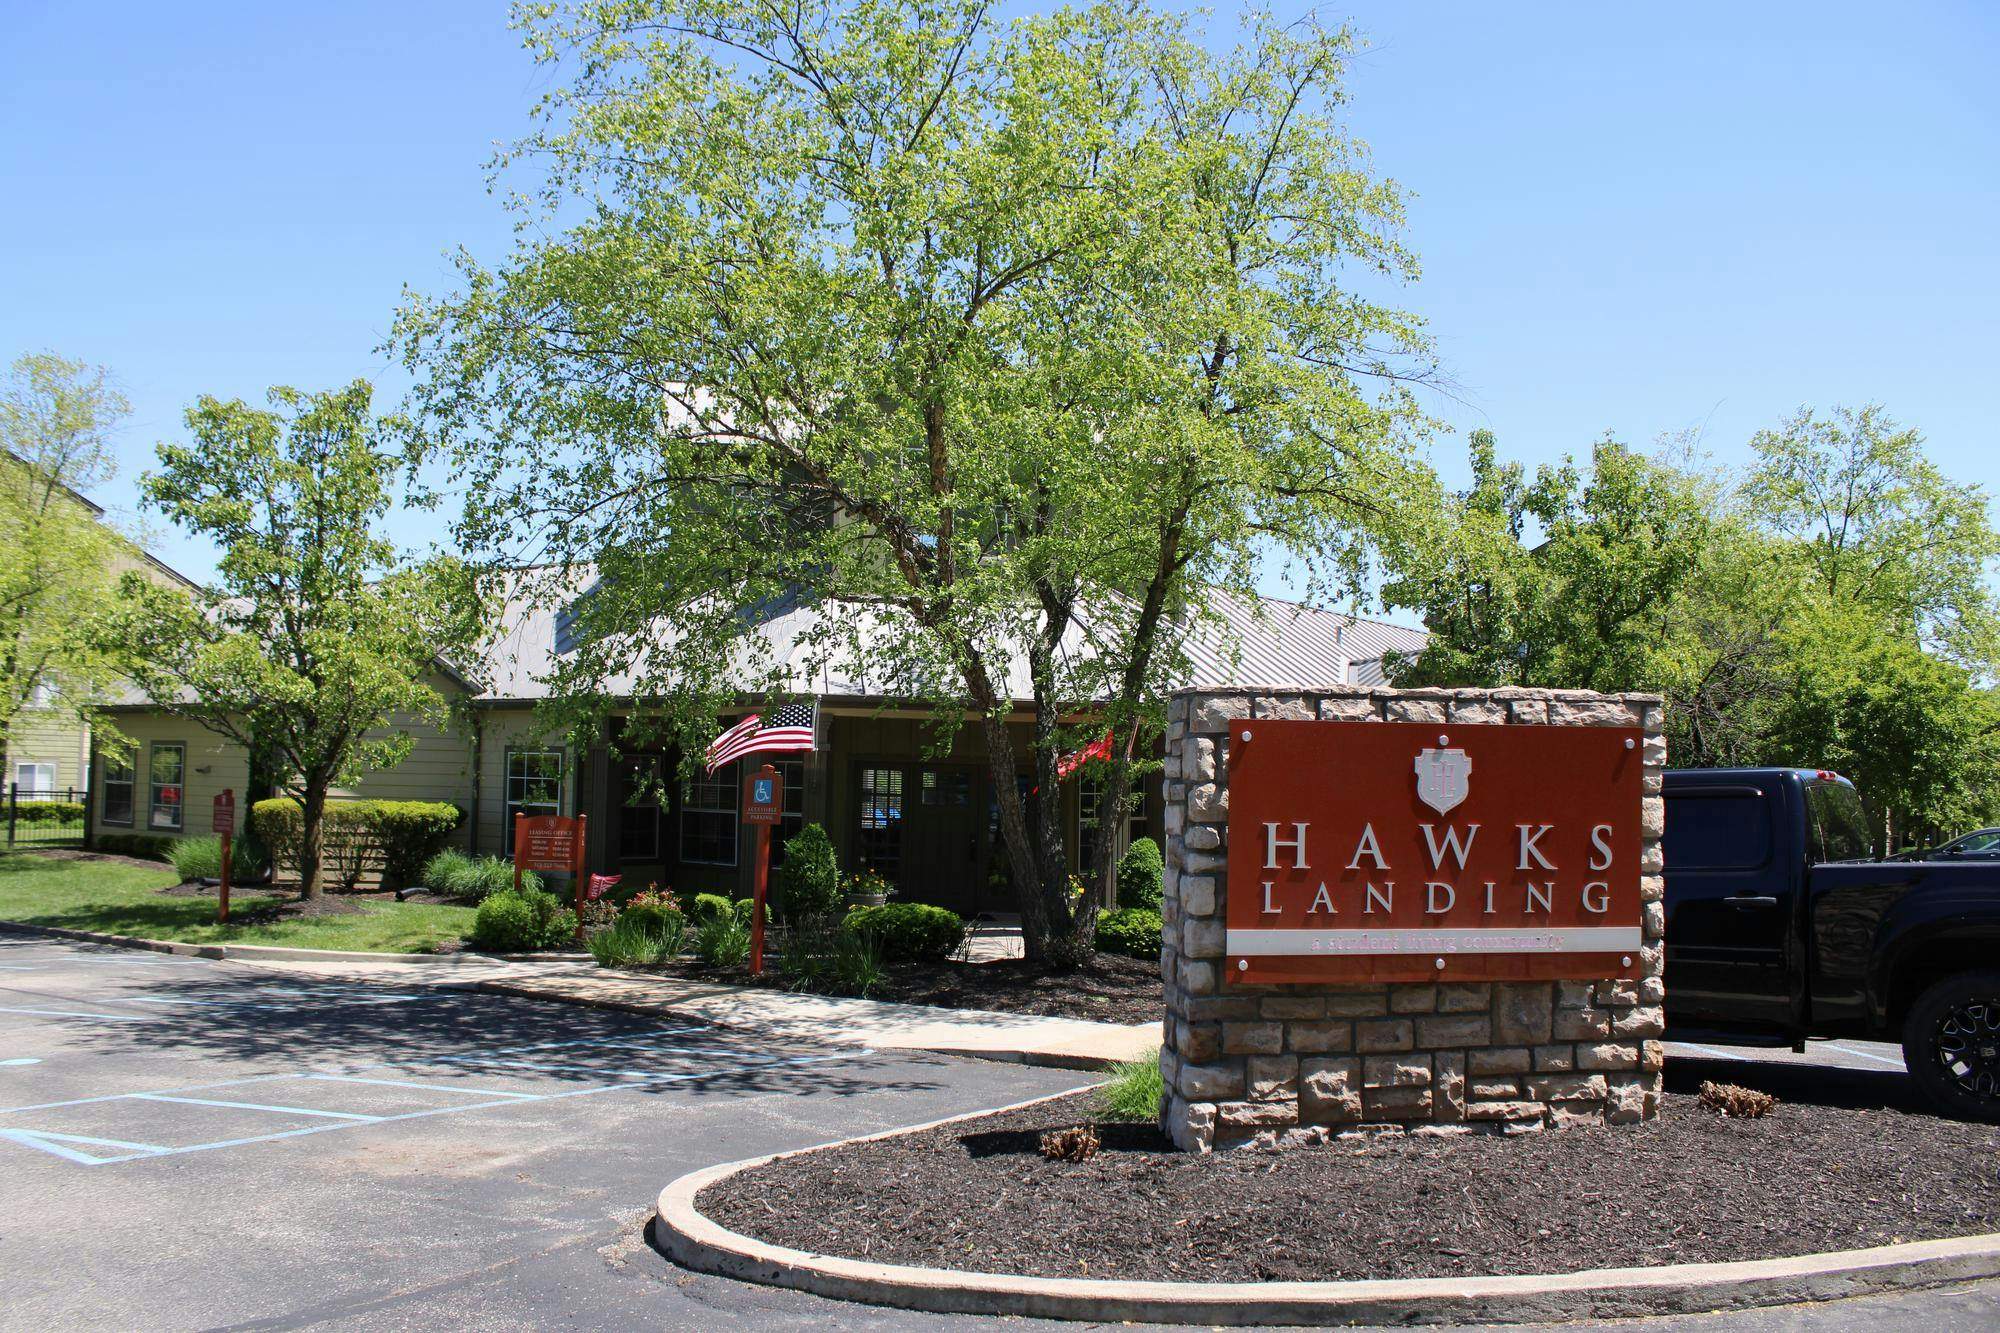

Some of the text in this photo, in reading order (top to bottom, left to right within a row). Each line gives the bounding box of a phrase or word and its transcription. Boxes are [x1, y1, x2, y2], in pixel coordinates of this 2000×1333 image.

[1262, 822, 1614, 870] HAWKS
[1261, 881, 1611, 914] LANDING
[1328, 935, 1399, 951] student
[1407, 934, 1457, 952] living
[1463, 934, 1566, 951] community
